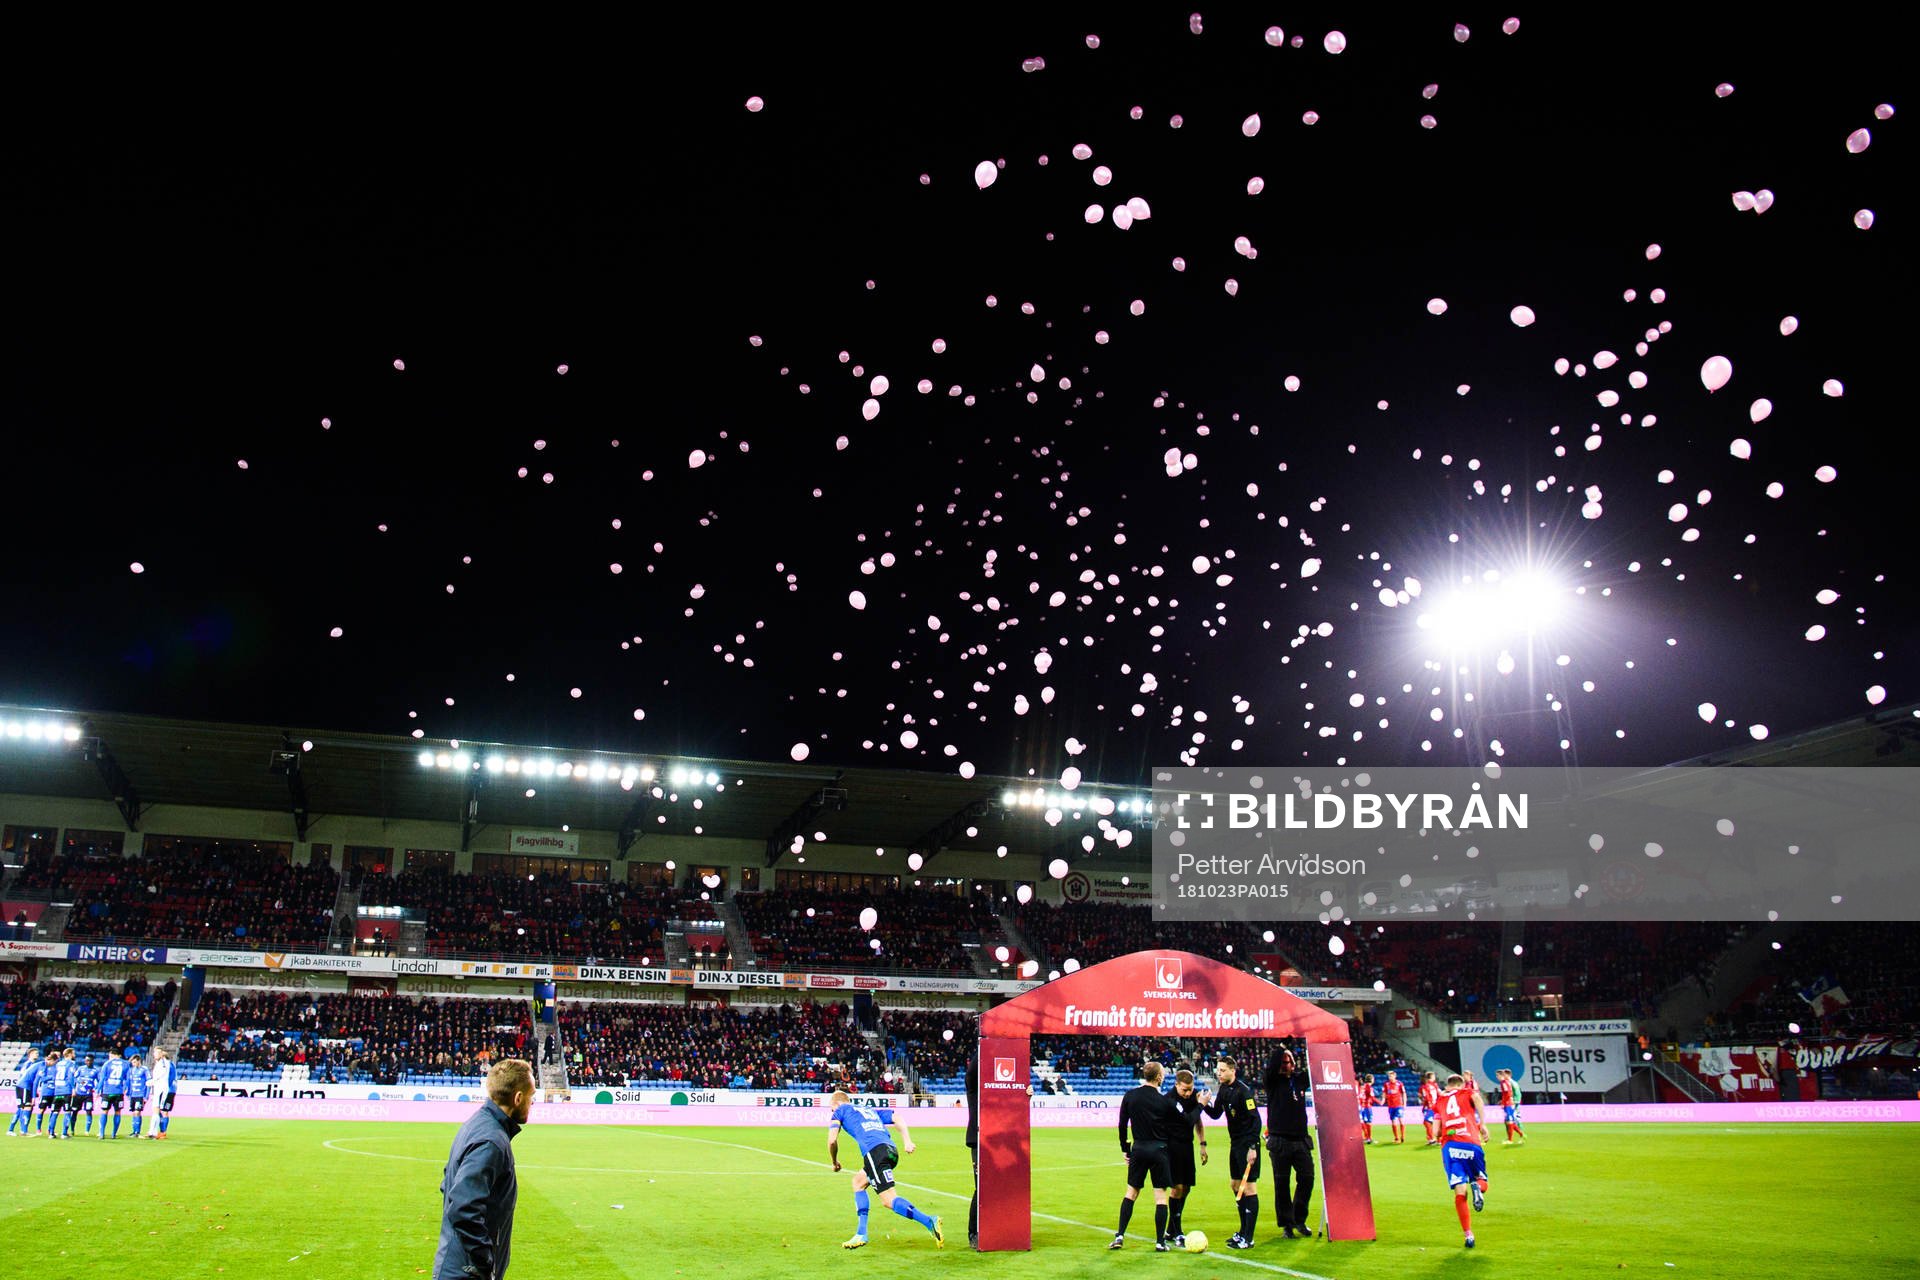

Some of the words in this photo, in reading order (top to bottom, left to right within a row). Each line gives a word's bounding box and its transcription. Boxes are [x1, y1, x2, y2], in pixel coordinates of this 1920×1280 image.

[290, 956, 311, 967] jkab
[313, 957, 362, 968] ARKITEKTER
[391, 959, 438, 973] Lindahl
[580, 968, 615, 979] DIN-X
[619, 970, 667, 981] BENSIN
[698, 972, 733, 984] DIN-X
[737, 973, 780, 985] DIESEL
[1143, 990, 1178, 999] SVENSKA
[1179, 992, 1197, 1000] SPEL
[1065, 1005, 1126, 1027] Framåt
[1129, 1006, 1155, 1028] för
[1157, 1008, 1211, 1029] svensk
[1214, 1008, 1275, 1030] fotboll!
[1457, 1026, 1509, 1034] KLIPPANS
[1511, 1025, 1539, 1033] BUSS
[1542, 1024, 1597, 1032] KLIPPANS
[1599, 1023, 1628, 1031] BUSS
[1528, 1046, 1606, 1063] Resurs
[1531, 1065, 1586, 1085] Bank
[615, 1091, 641, 1102] Solid
[690, 1093, 715, 1103] Solid
[764, 1097, 813, 1107] PEAB
[1446, 1095, 1461, 1116] 4
